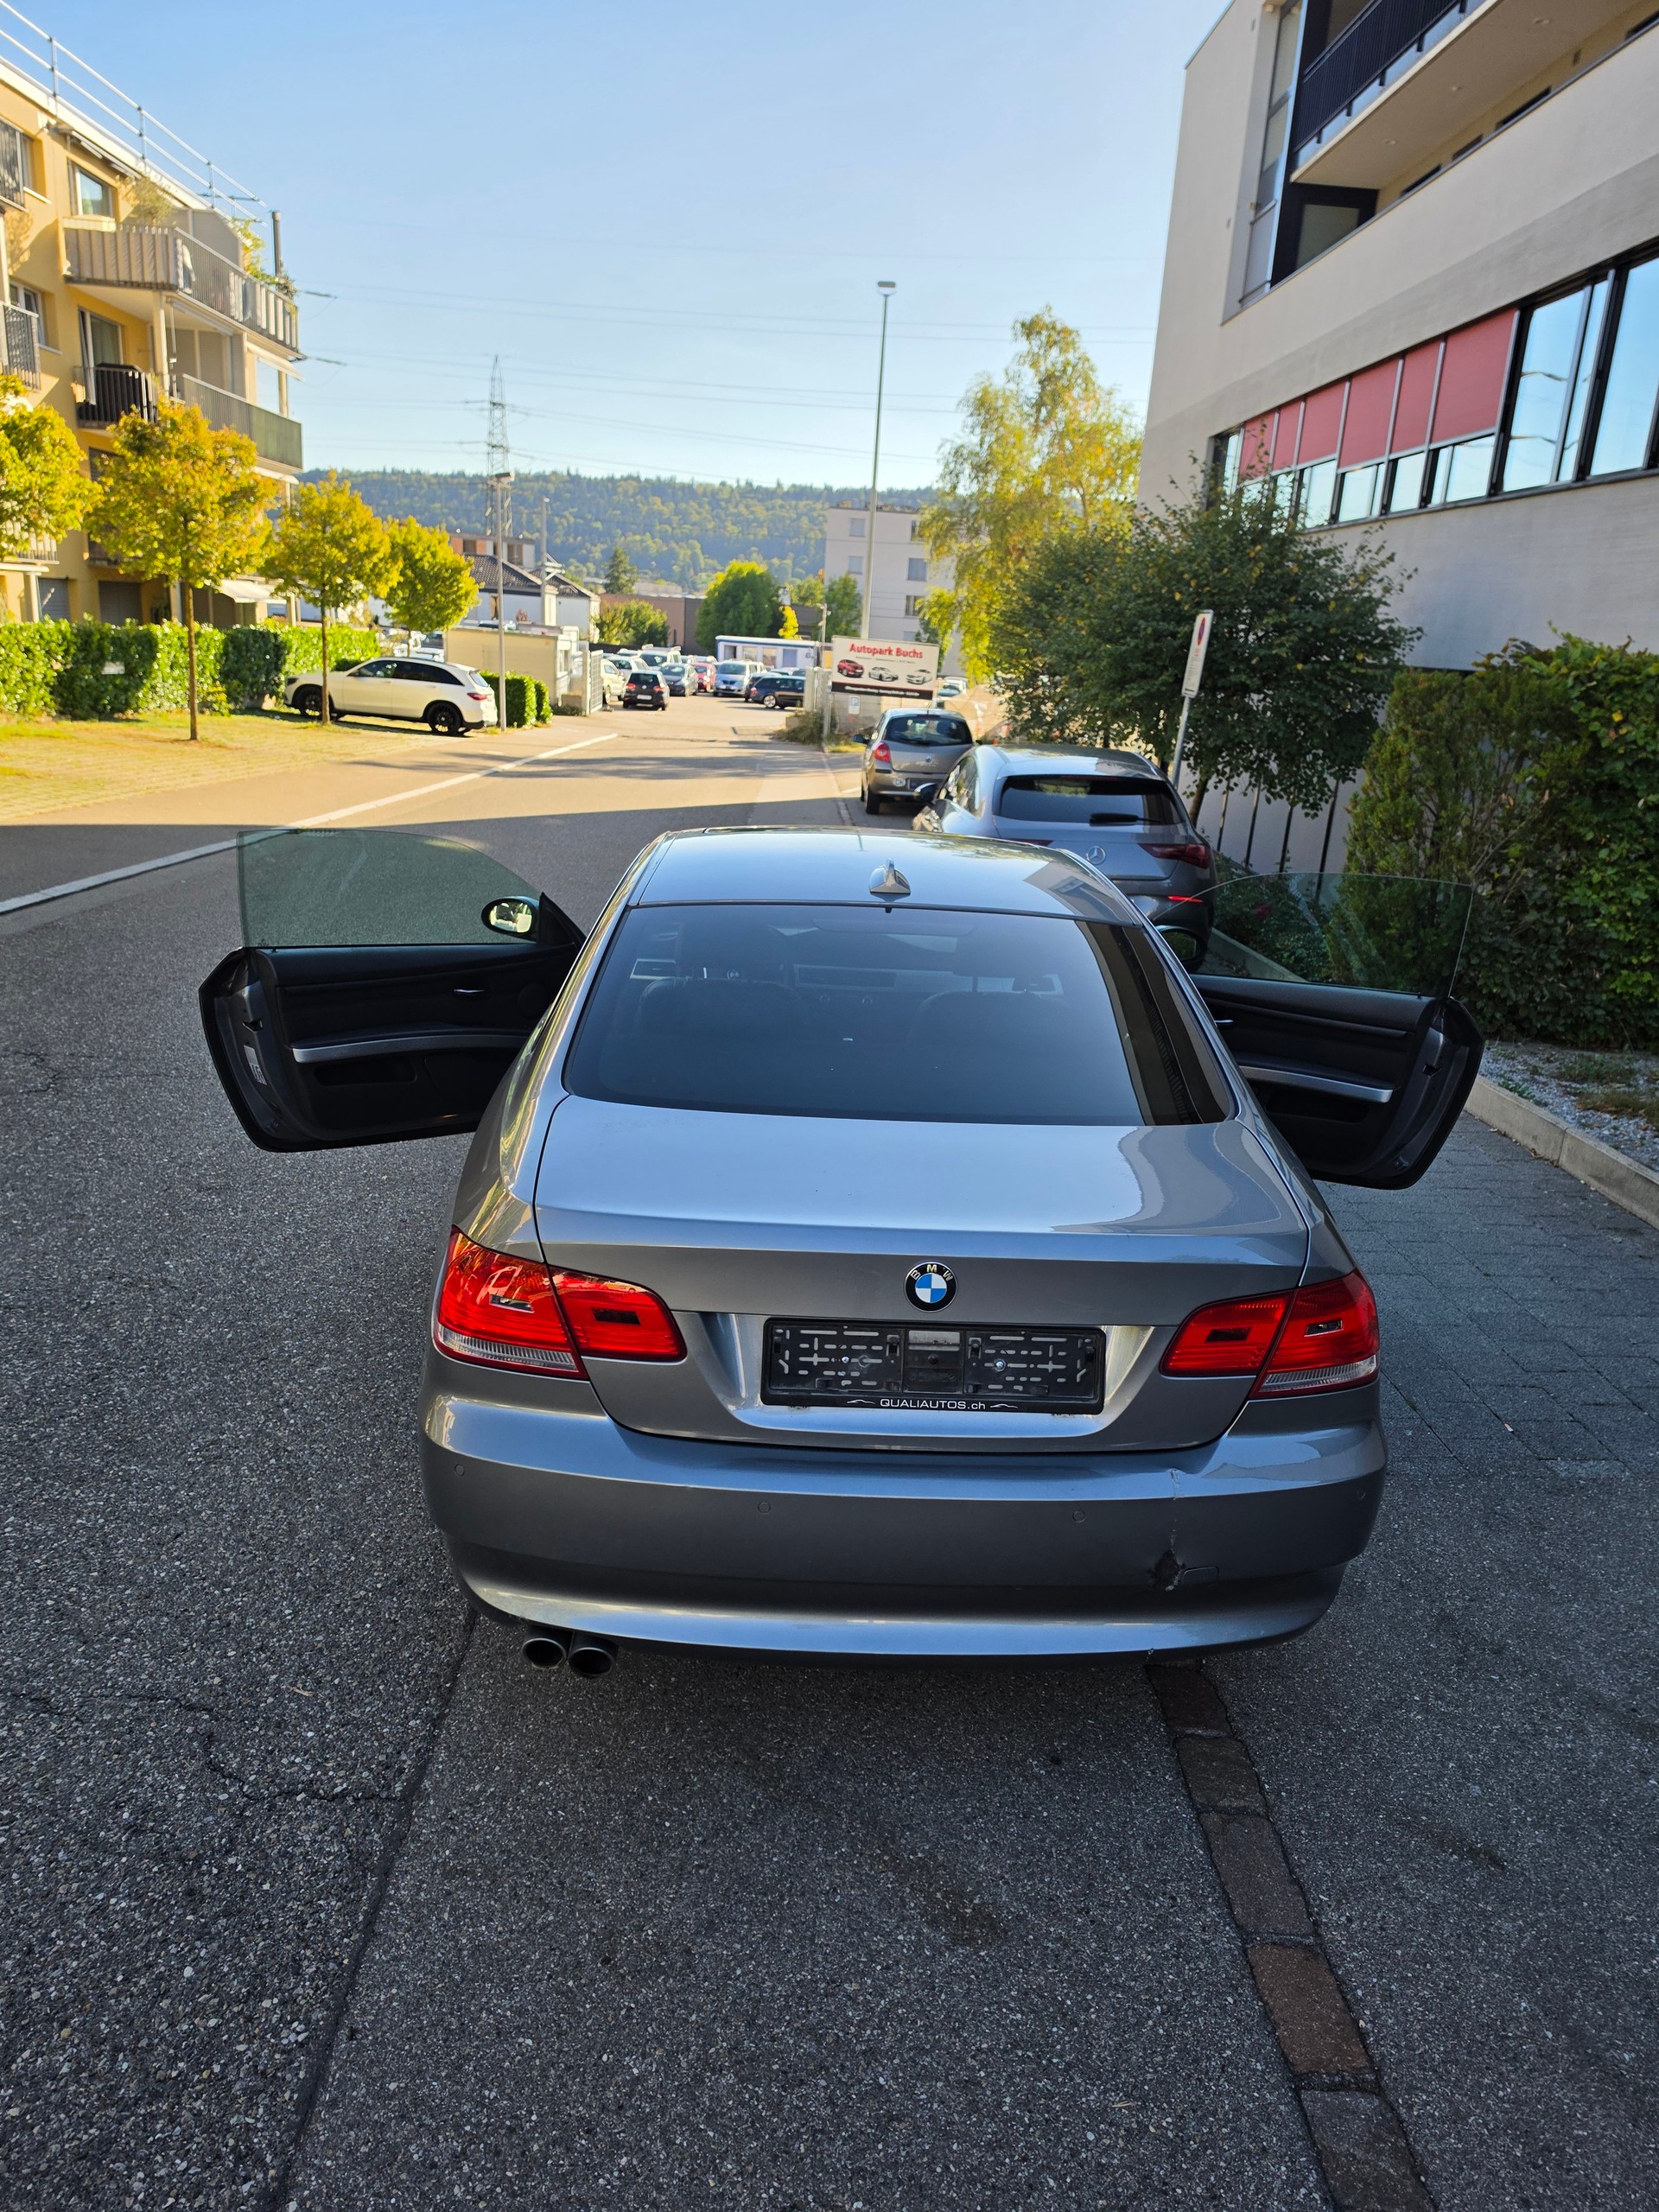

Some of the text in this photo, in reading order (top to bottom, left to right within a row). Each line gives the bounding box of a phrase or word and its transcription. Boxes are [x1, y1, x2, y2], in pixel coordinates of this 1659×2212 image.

[849, 643, 923, 658] Autopark Buchs
[910, 1264, 953, 1281] BMW
[880, 1398, 986, 1410] QUALIAUTOS.ch
